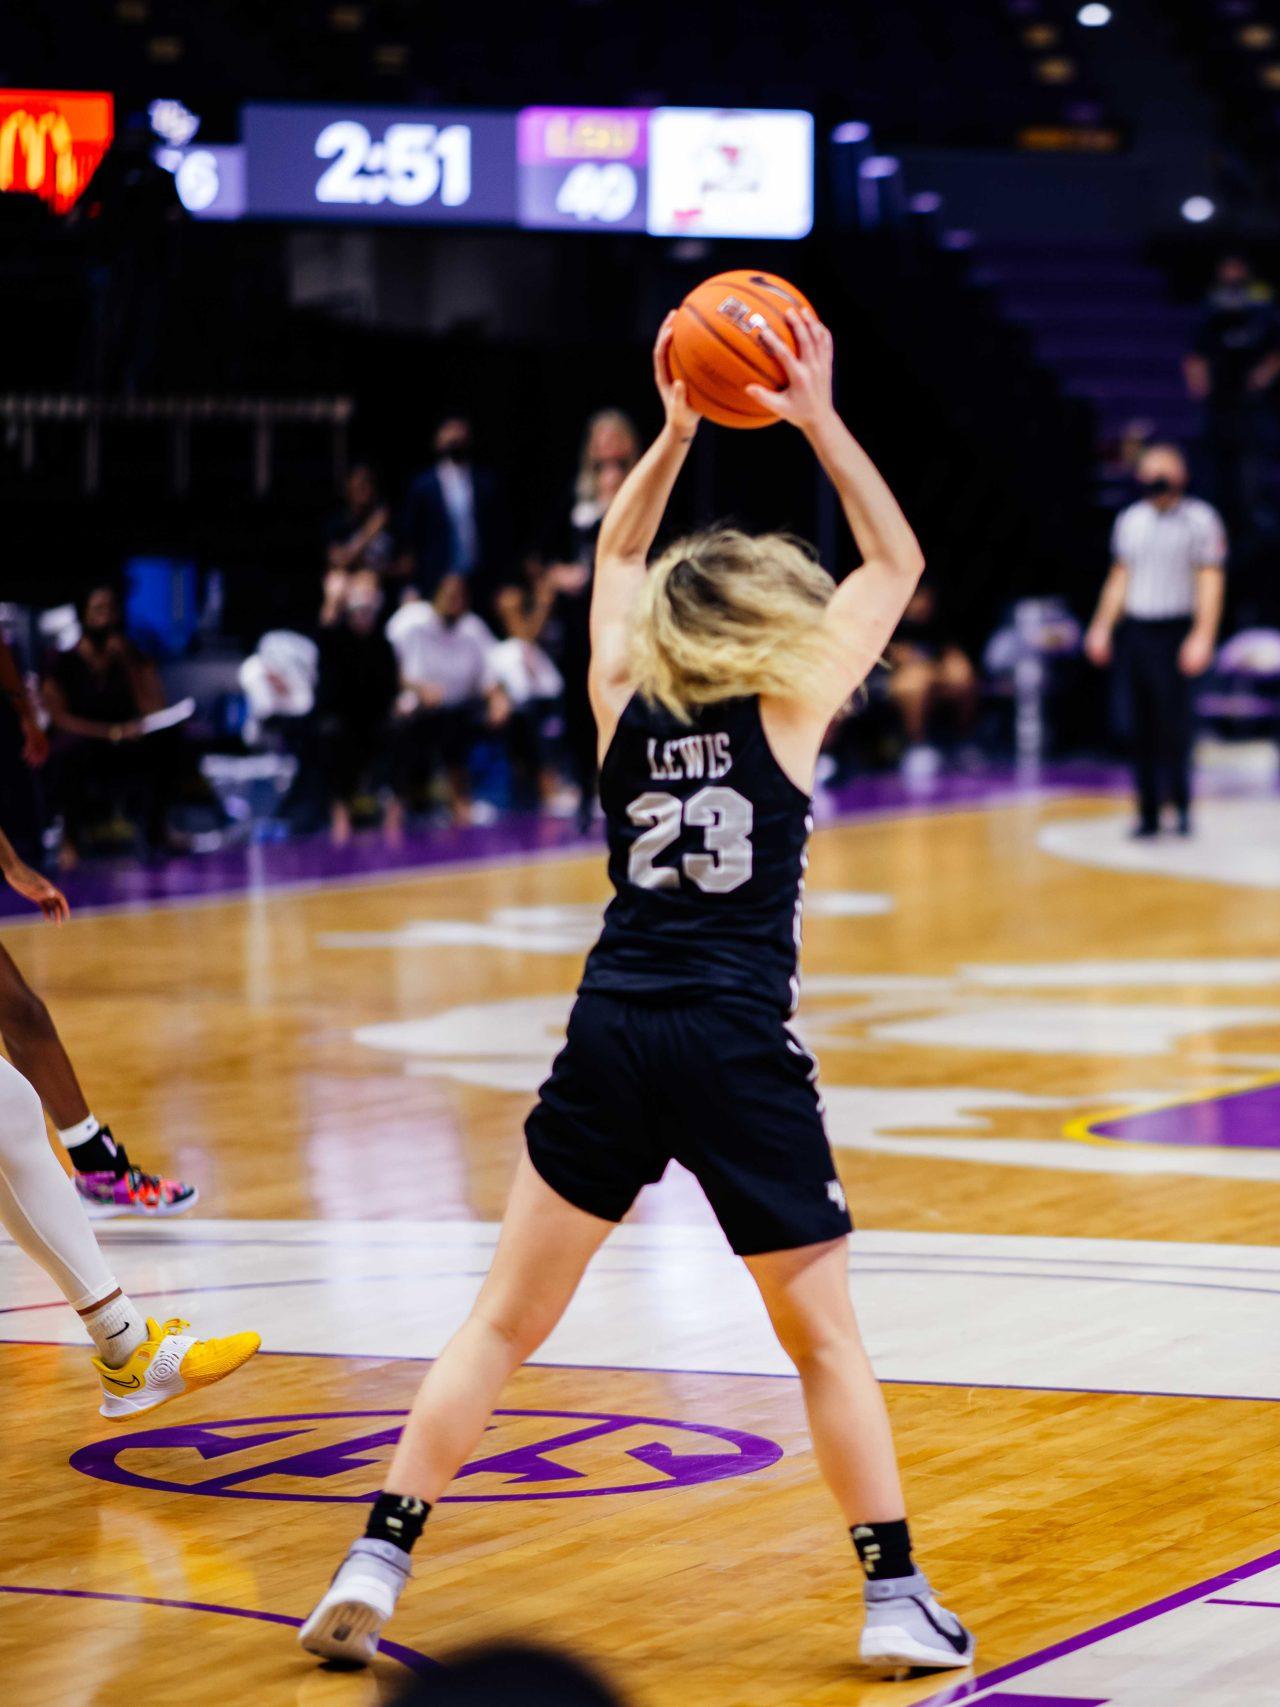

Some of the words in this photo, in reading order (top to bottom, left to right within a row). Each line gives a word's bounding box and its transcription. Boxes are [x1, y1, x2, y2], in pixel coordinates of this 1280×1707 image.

[314, 120, 471, 206] 2:51
[646, 732, 733, 780] LEWIS
[626, 786, 753, 893] 23
